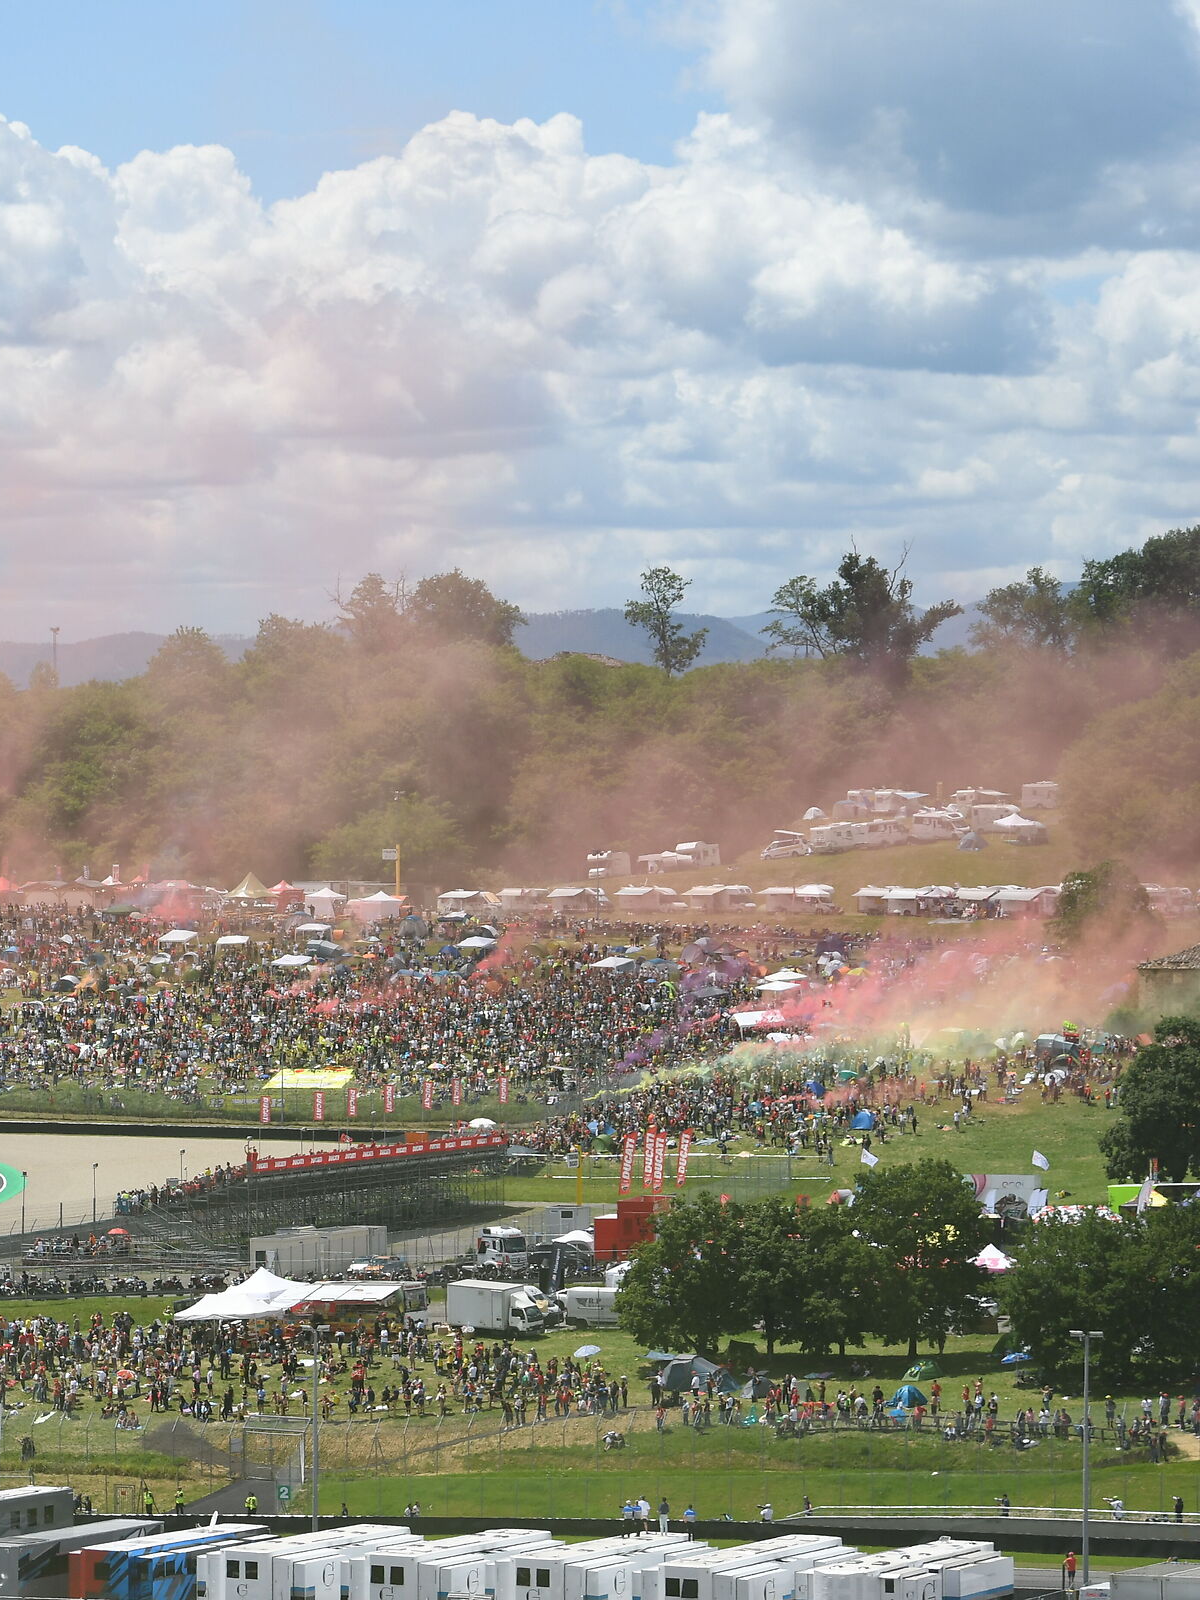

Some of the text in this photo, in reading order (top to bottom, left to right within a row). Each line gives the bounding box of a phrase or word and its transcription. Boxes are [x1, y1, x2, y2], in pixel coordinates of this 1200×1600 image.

[622, 1138, 635, 1177] DUCATI
[644, 1133, 655, 1173] DUCATI
[654, 1137, 665, 1179] DUCATI
[678, 1133, 690, 1173] DUCATI
[280, 1486, 289, 1499] 2
[237, 1584, 248, 1597] G
[322, 1562, 335, 1587] G
[614, 1568, 626, 1595] G
